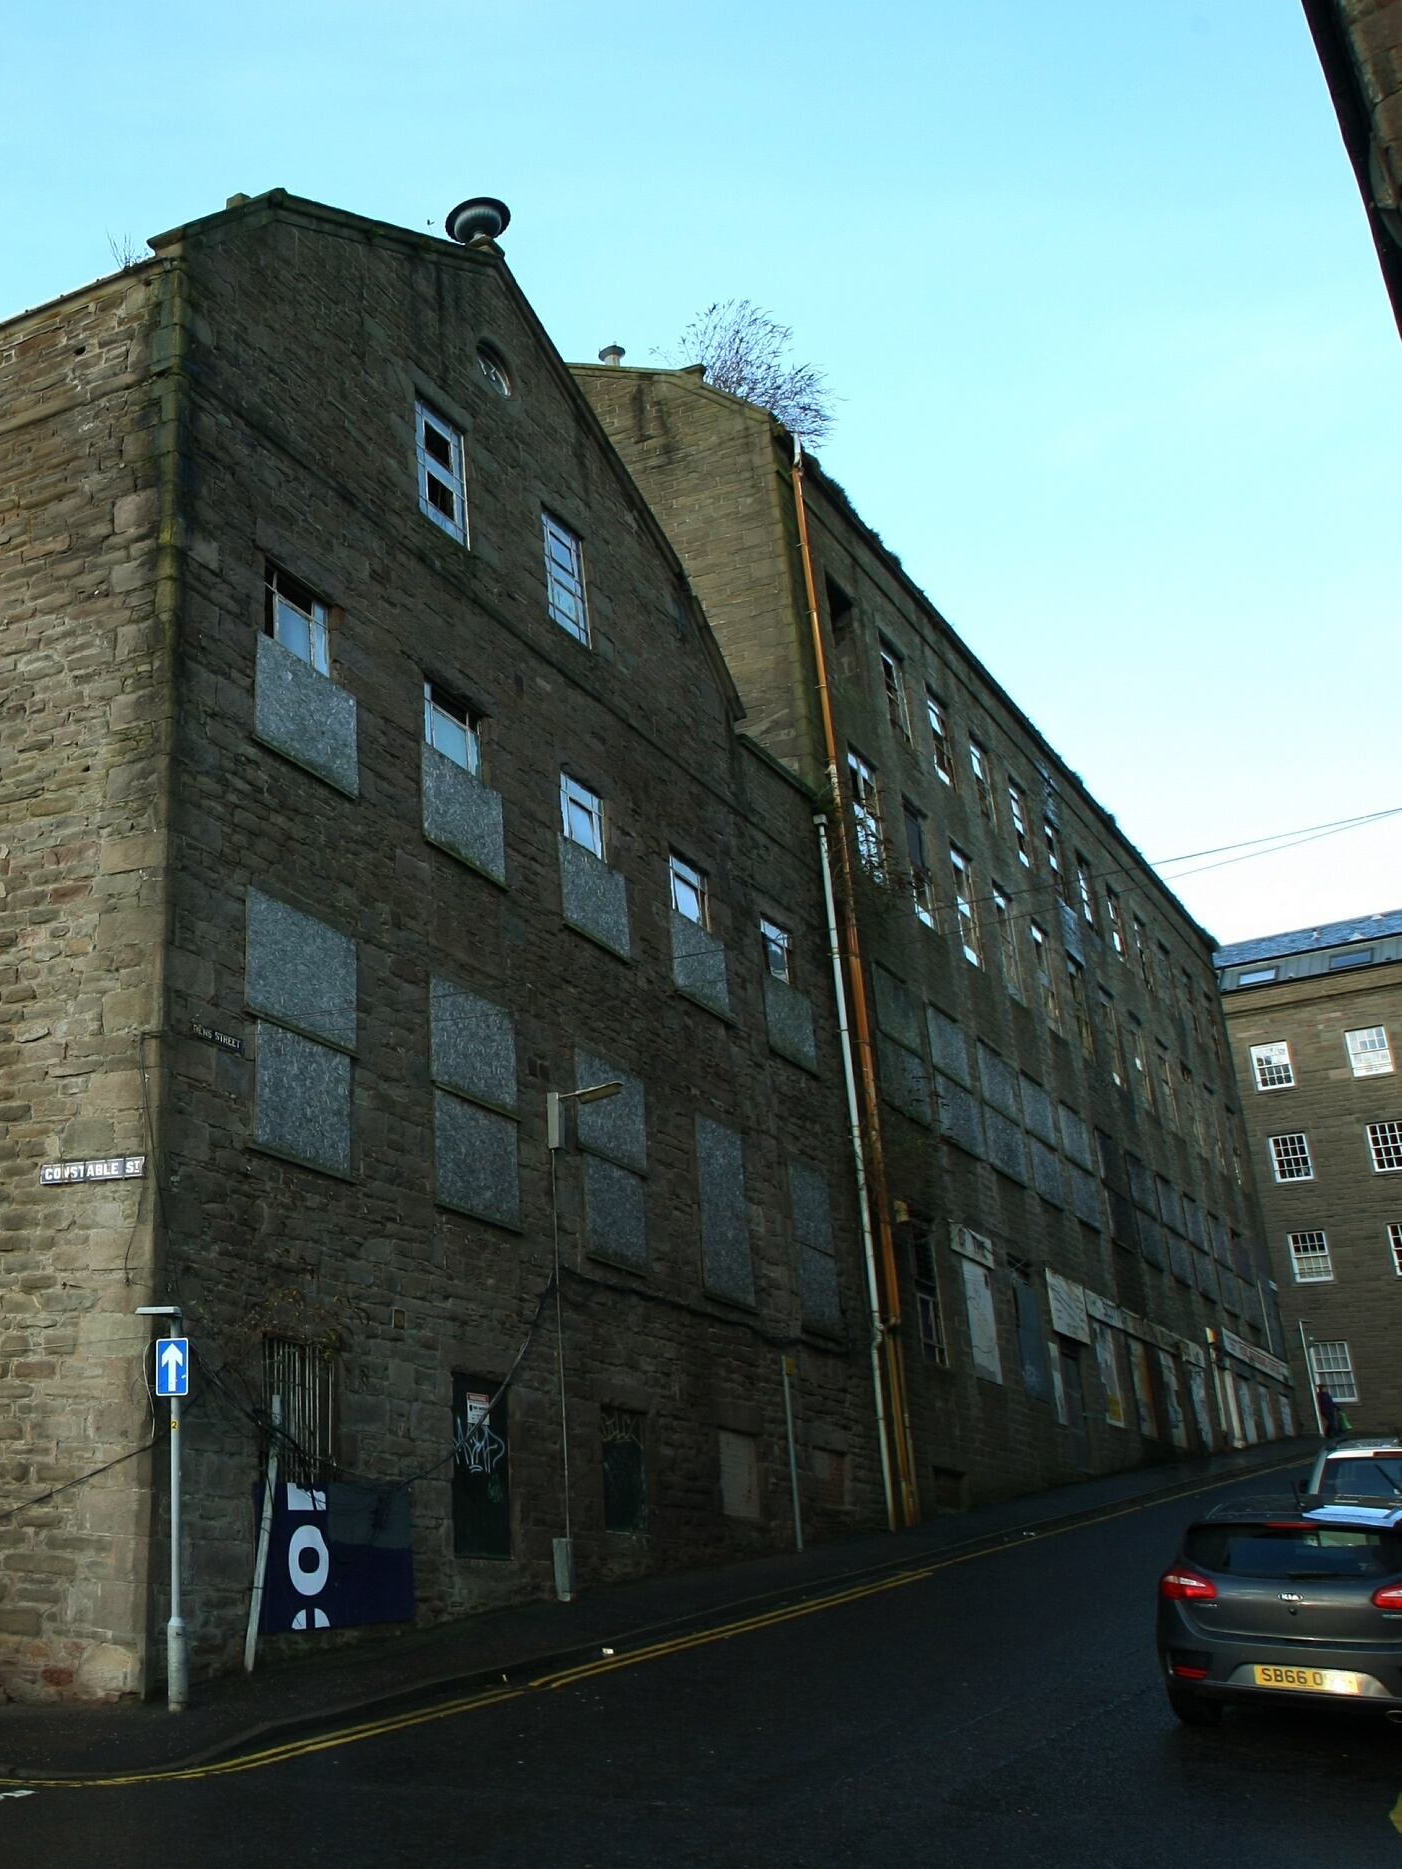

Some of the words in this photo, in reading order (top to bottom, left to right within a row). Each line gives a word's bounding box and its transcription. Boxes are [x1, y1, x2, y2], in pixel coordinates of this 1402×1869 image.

[214, 1031, 241, 1049] STREET
[44, 1162, 119, 1180] CONSTABLE
[125, 1160, 141, 1174] ST
[1280, 1592, 1300, 1601] KIA
[1261, 1667, 1308, 1685] SB66
